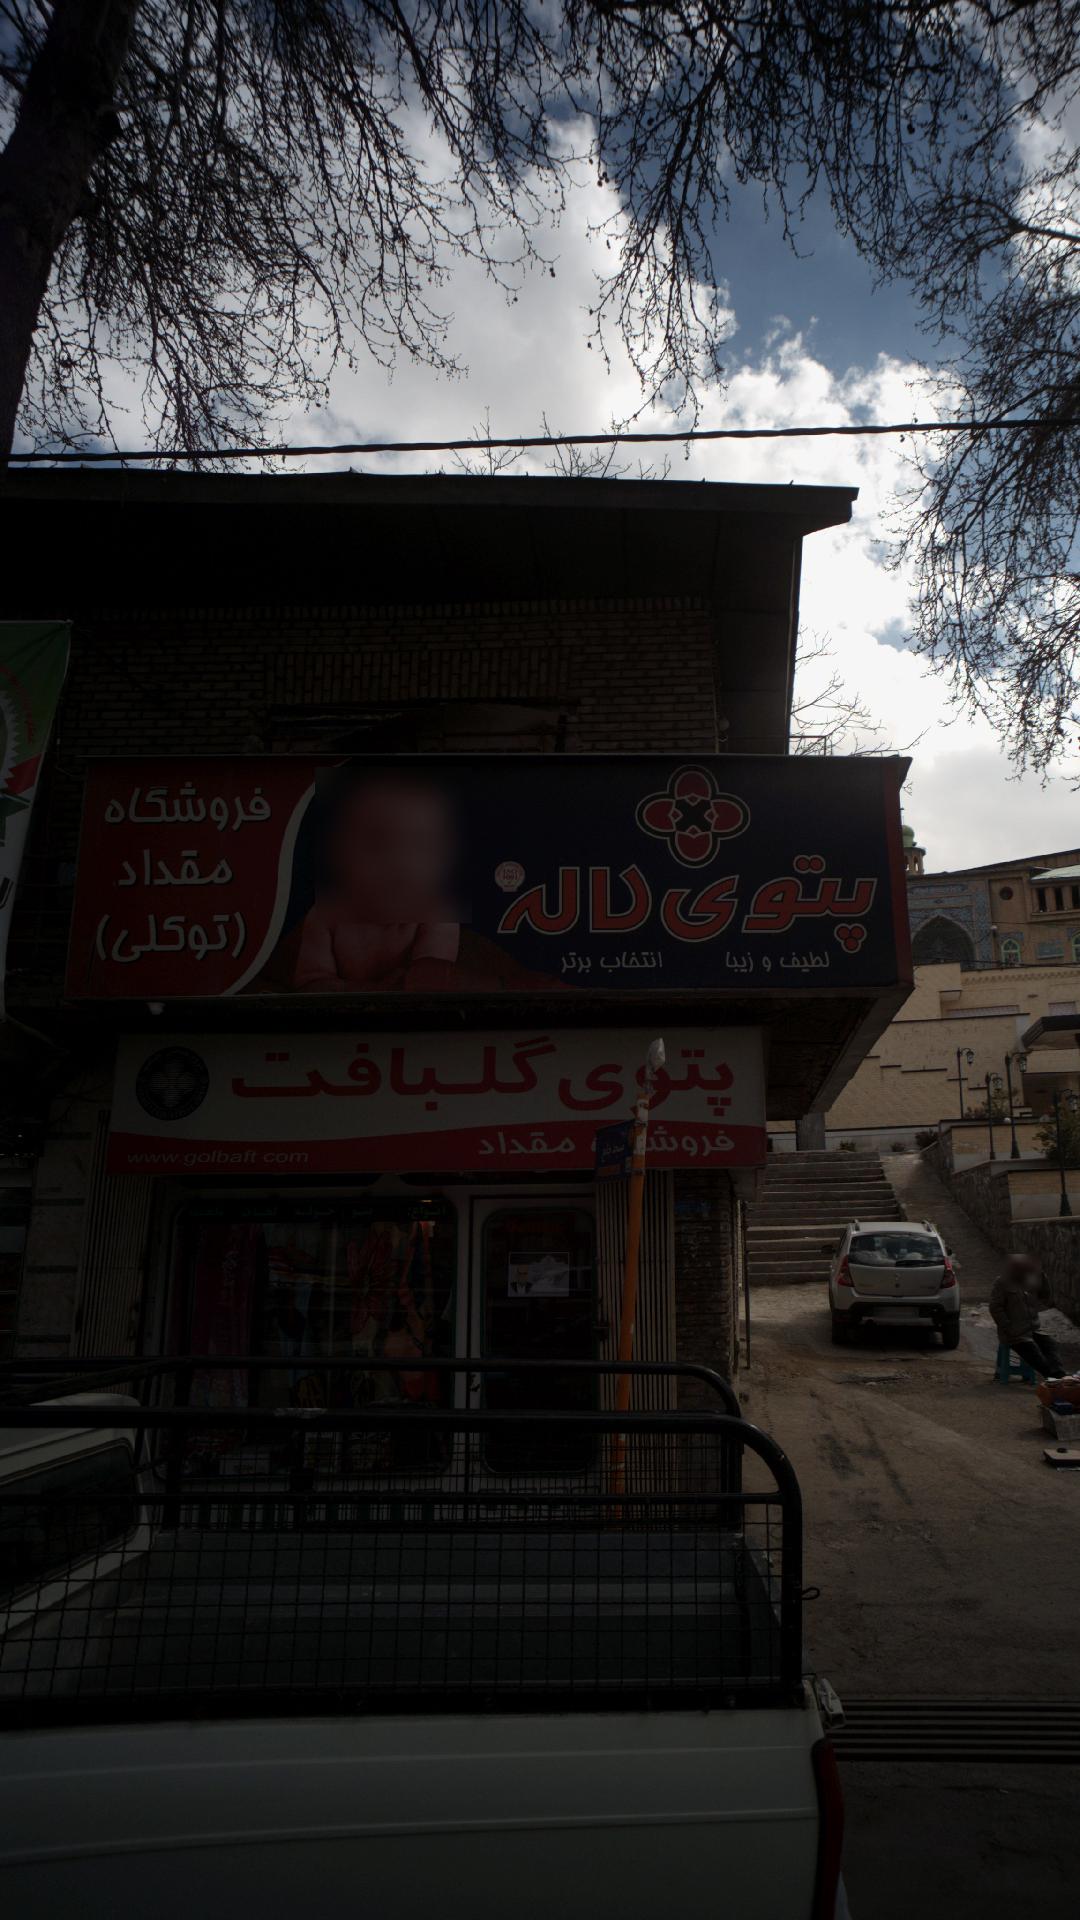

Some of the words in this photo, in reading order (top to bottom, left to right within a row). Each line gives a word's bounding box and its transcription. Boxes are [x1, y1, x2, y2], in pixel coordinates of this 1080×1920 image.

[104, 781, 272, 831] فروشگاه
[117, 848, 233, 887] مقداد
[498, 864, 653, 935] لاله
[660, 854, 878, 953] پتوی
[95, 912, 246, 962] (توکلی)
[560, 952, 593, 975] برتر
[599, 951, 663, 974] انتخاب
[725, 951, 755, 976] زیبا
[762, 957, 773, 974] و
[780, 950, 830, 975] لطیف
[232, 1035, 556, 1110] گلبافت
[559, 1049, 734, 1116] پتوی
[478, 1130, 575, 1156] مقداد
